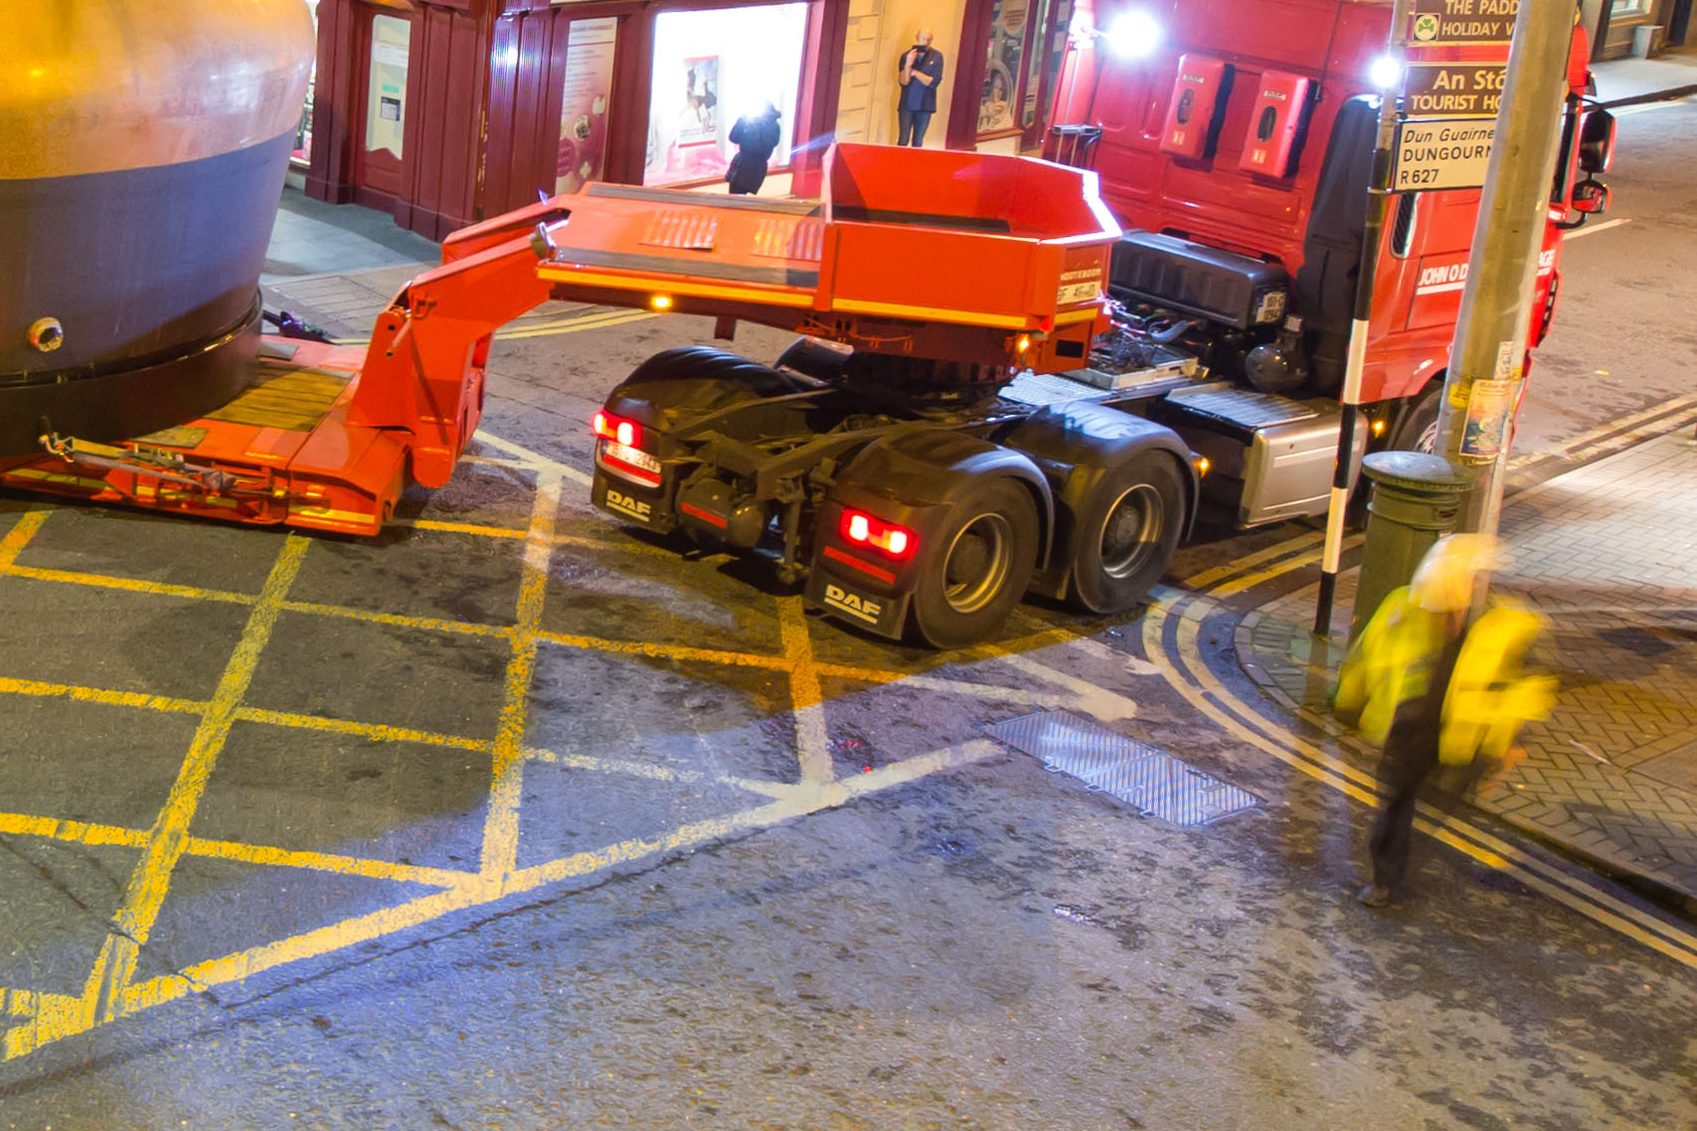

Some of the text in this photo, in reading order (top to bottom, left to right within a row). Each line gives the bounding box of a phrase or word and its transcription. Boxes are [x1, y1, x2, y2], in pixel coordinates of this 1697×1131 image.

[1478, 0, 1520, 16] PADD
[1442, 22, 1500, 36] HOLIDAY
[1432, 68, 1507, 90] An Stó
[1411, 94, 1479, 110] TOURIST
[1404, 128, 1495, 143] Dun Guairne
[1418, 266, 1449, 286] JOHN
[607, 489, 651, 514] DAF
[825, 584, 881, 615] DAF
